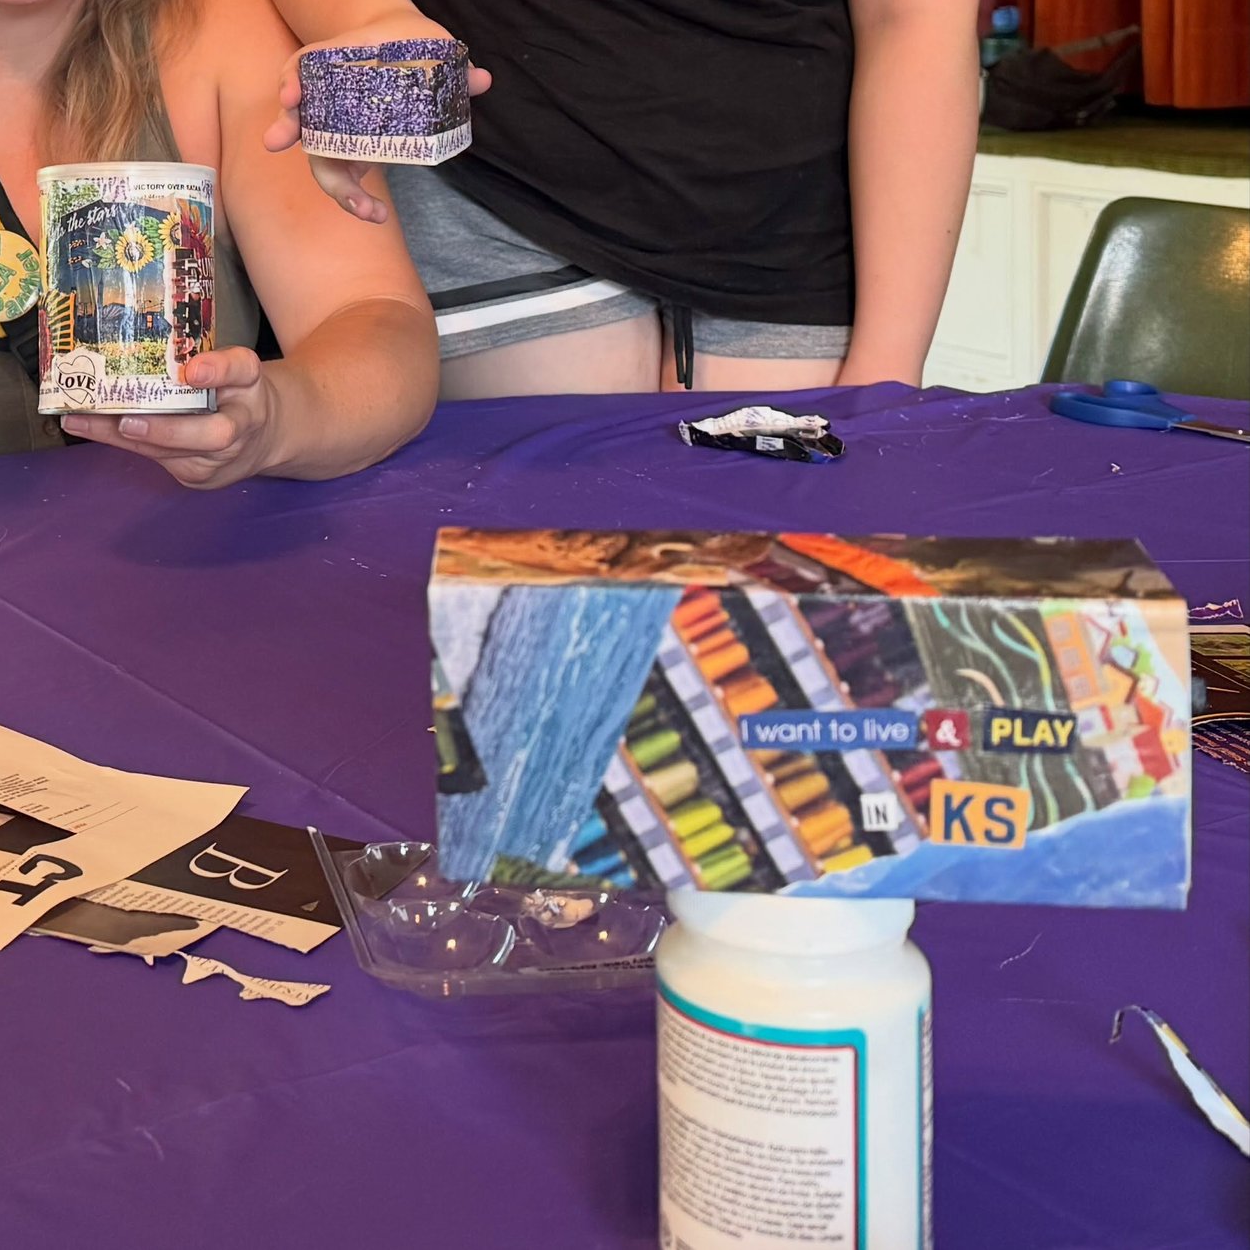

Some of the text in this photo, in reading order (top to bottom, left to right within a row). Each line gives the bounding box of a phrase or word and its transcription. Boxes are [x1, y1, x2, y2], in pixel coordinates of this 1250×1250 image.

[134, 183, 165, 191] VICTORY
[167, 183, 185, 191] OVER
[67, 212, 87, 232] the
[87, 204, 118, 226] stars
[58, 371, 96, 391] LOVE
[742, 718, 1074, 747] I want to live & PLAY
[867, 793, 1016, 844] IN KS
[189, 842, 289, 890] B
